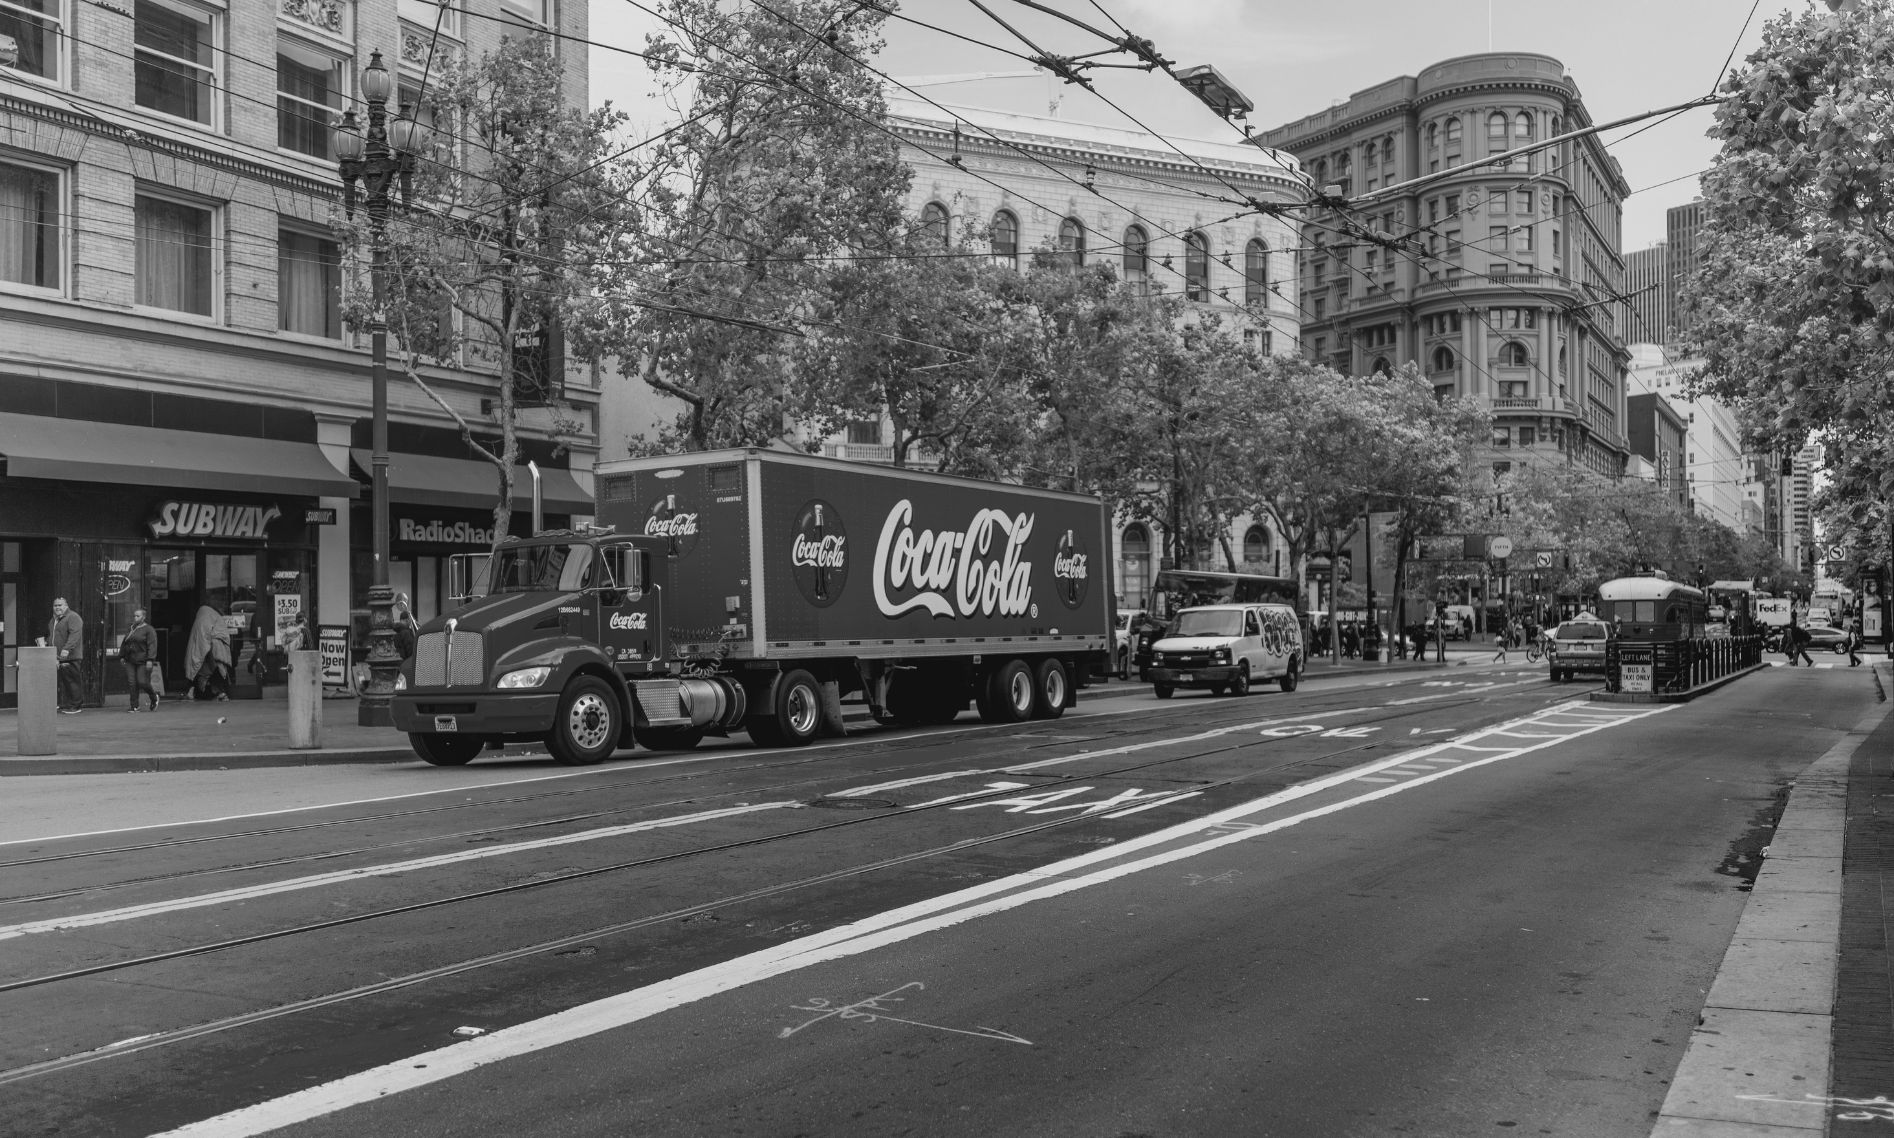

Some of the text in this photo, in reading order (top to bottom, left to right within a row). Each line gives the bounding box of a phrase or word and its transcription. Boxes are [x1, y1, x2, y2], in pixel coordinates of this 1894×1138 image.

[1655, 368, 1675, 377] PHELAN
[150, 501, 281, 539] SUBWAY
[305, 511, 333, 523] SUBWAY
[644, 512, 700, 537] Coca-Cola
[400, 518, 494, 545] RadioShac
[792, 533, 846, 568] Coca-Cola
[873, 499, 1036, 617] Coca-Cola
[1054, 551, 1088, 579] Coca-Cola
[277, 599, 298, 608] $3.50
[1759, 603, 1787, 613] FedEx
[610, 612, 648, 630] Coca-Cola
[321, 642, 345, 653] Now
